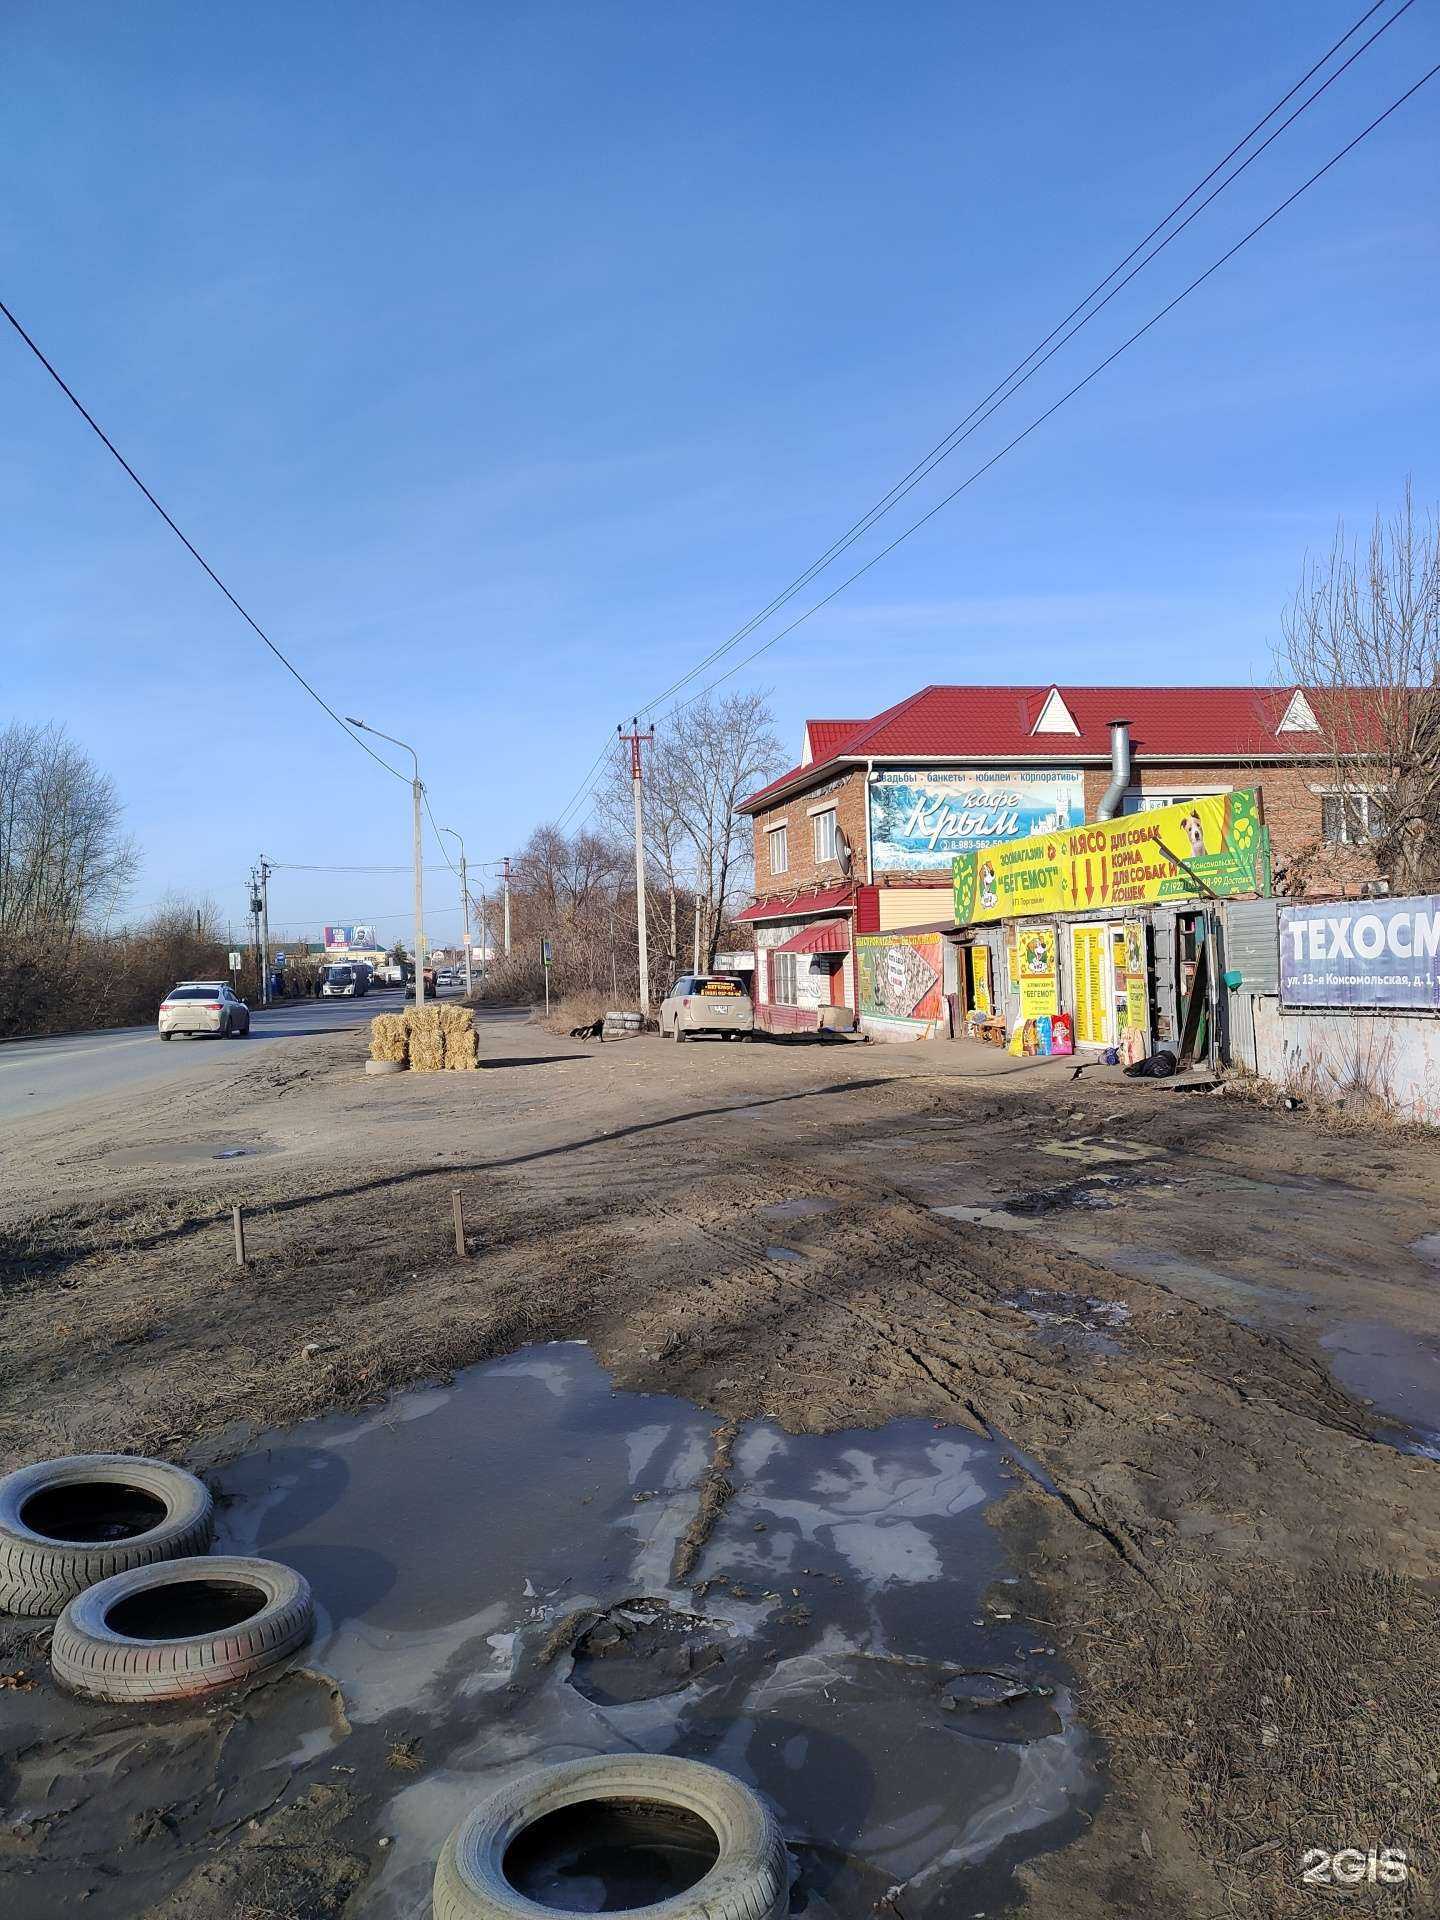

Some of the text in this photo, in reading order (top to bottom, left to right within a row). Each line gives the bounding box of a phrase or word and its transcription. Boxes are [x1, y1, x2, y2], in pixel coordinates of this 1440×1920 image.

[927, 772, 965, 782] банкеты
[1020, 772, 1079, 783] корпоративы
[963, 794, 1019, 811] кафе
[904, 794, 1020, 850] Крым
[1069, 825, 1162, 856] МЯСО ДЛЯ СОБАК
[1000, 846, 1043, 866] ЗООМАГАЗИН
[1111, 849, 1143, 868] КОРМА
[1112, 870, 1130, 888] ДЛЯ
[1129, 863, 1167, 883] СОБАК
[1169, 862, 1178, 878] И
[1111, 885, 1146, 902] КОШЕК
[1288, 912, 1440, 961] ТЕХОСМ
[1287, 976, 1301, 988] ул.
[1302, 974, 1325, 985] 13-я
[1326, 973, 1412, 987] Комсомольская,
[1413, 975, 1424, 986] д.
[1425, 973, 1434, 987] 1,
